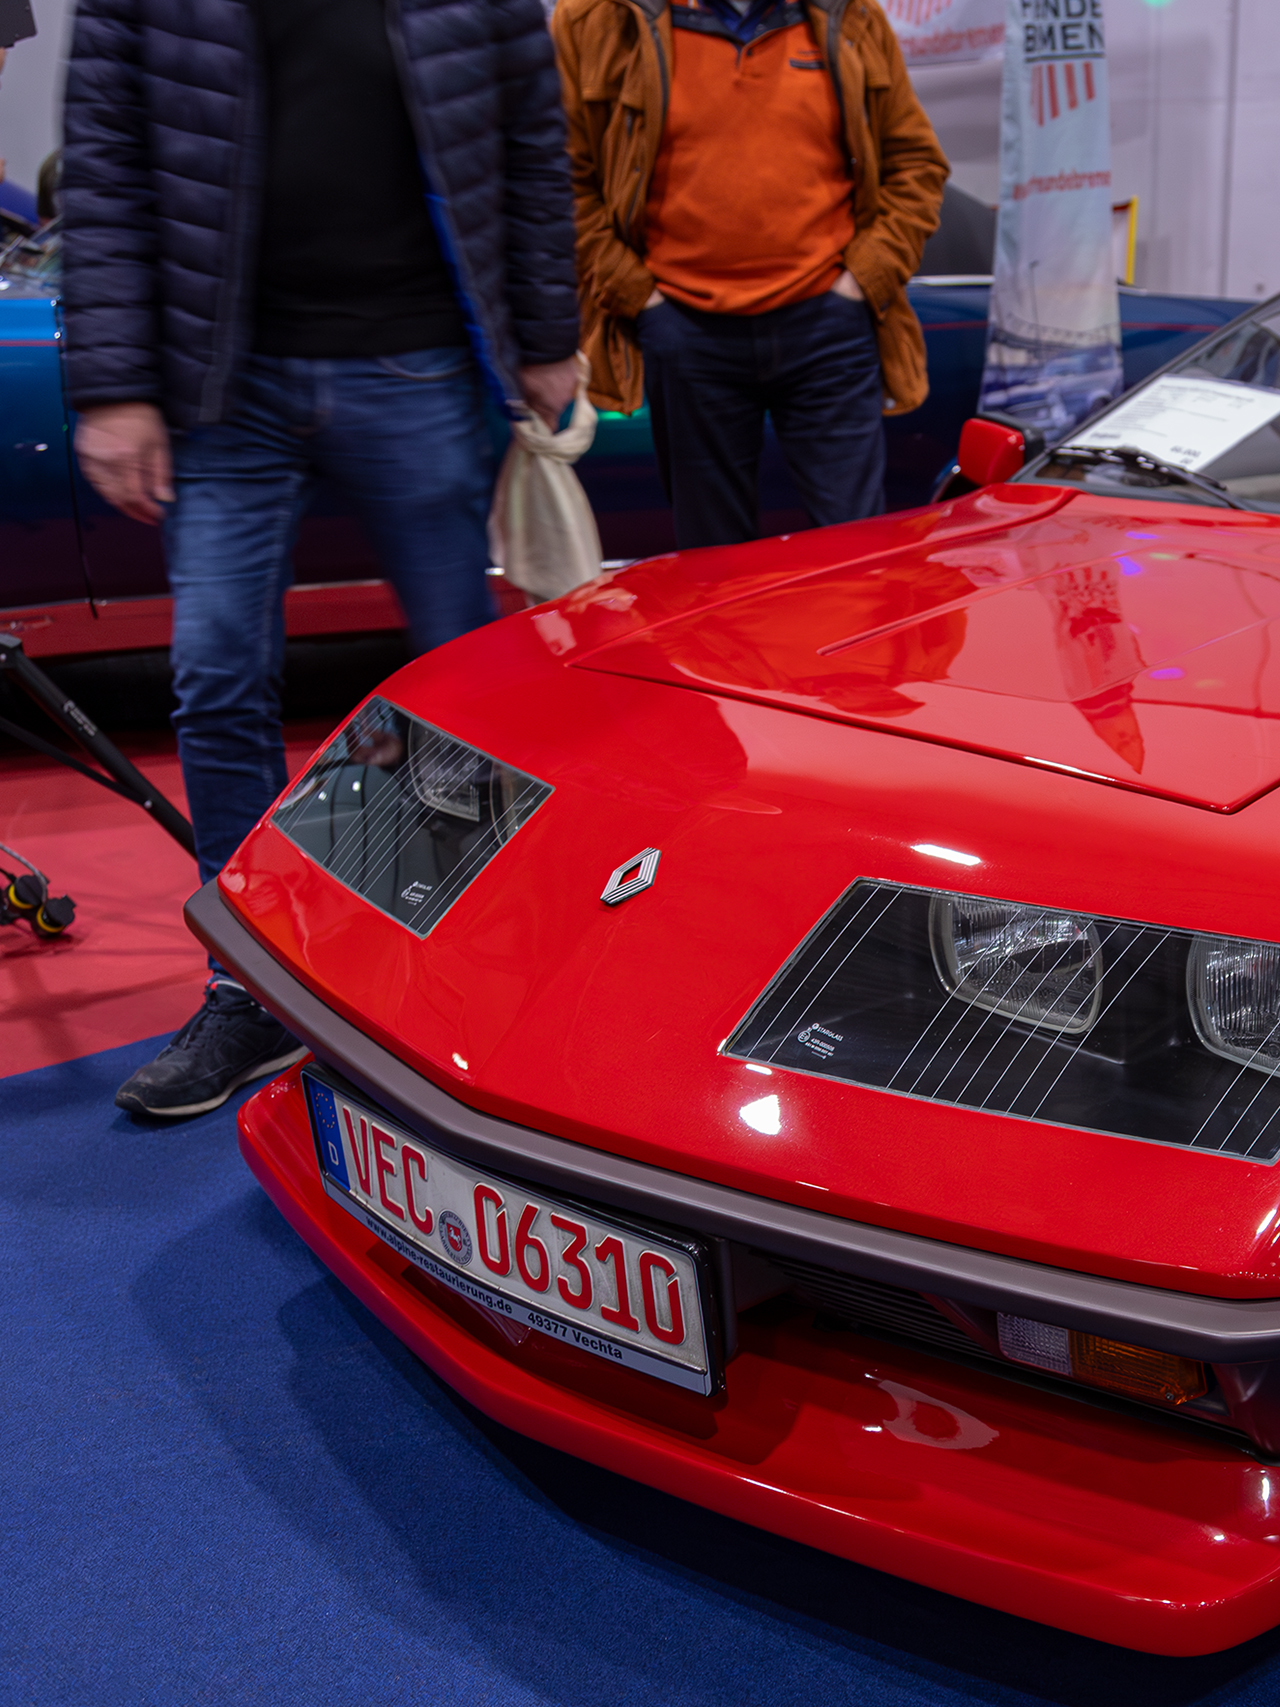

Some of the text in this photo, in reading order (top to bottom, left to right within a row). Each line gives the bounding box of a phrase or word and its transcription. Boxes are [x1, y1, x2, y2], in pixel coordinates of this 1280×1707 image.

[328, 1140, 339, 1166] D
[342, 1104, 686, 1346] VEC 06310
[365, 1216, 513, 1315] www.alpine-restaurierung.de
[527, 1312, 568, 1337] 49377
[572, 1329, 623, 1360] Vechta
